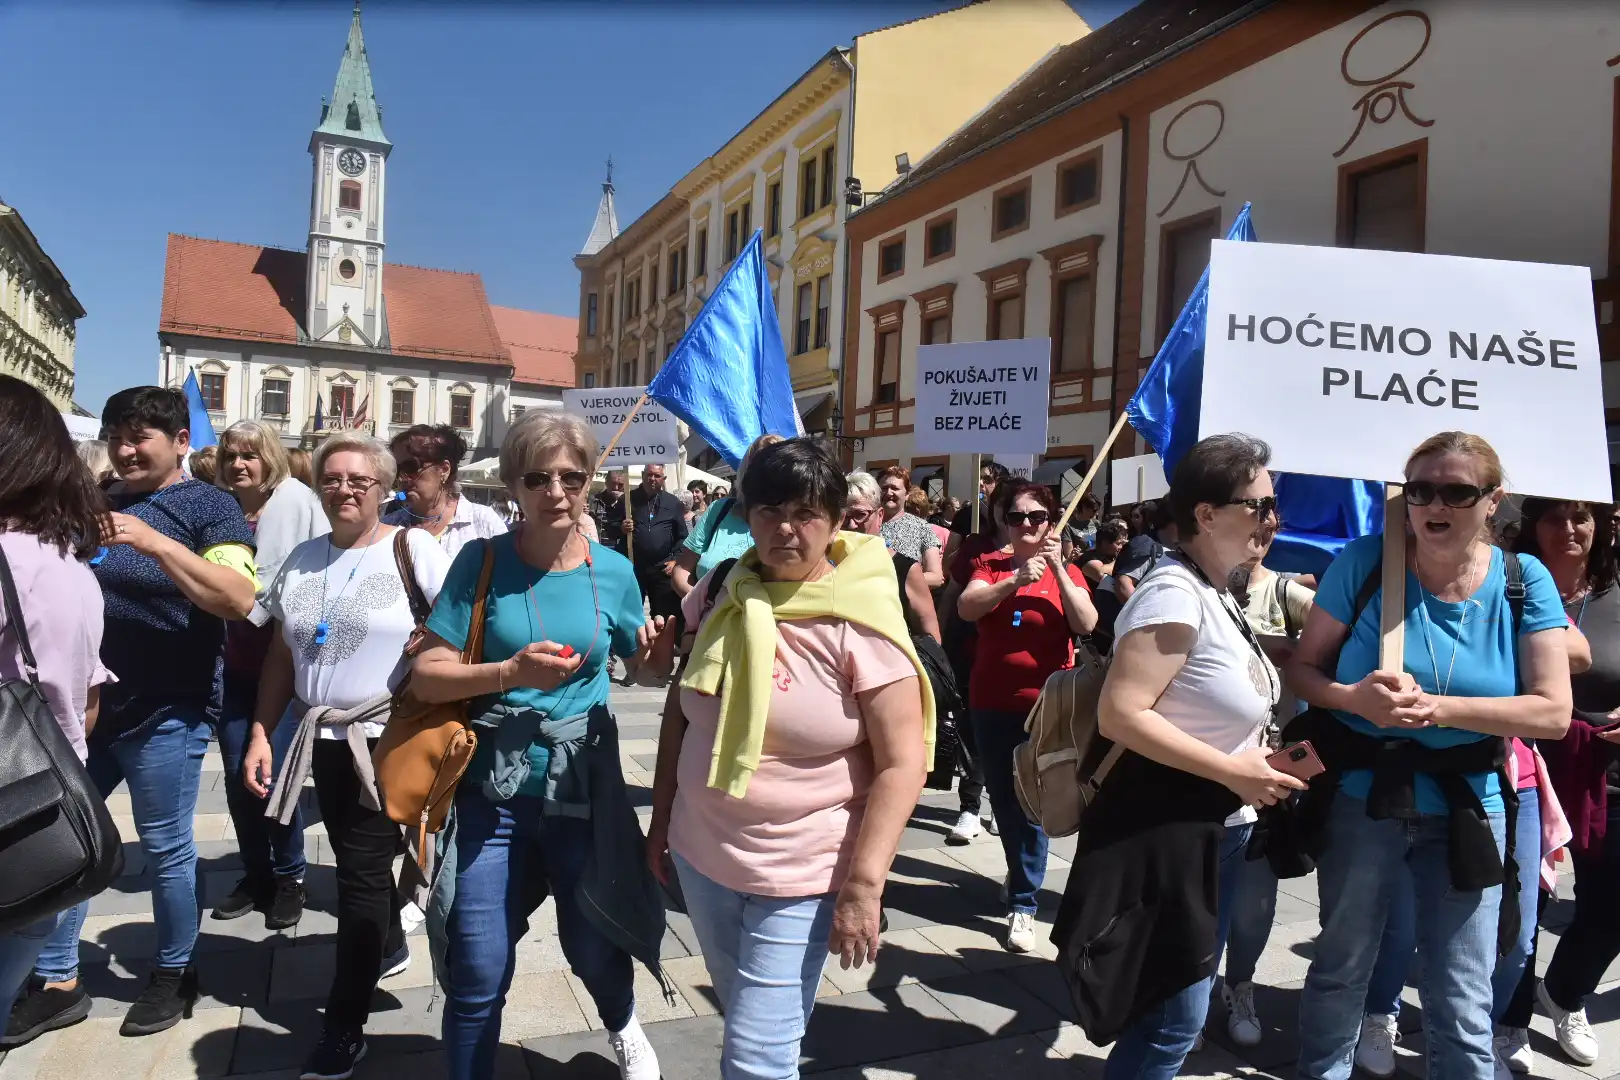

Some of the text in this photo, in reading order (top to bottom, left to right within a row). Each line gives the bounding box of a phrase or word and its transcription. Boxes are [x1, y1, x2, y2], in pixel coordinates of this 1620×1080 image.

[1227, 313, 1578, 370] HOĆEMO NAŠE
[924, 366, 1038, 385] POKUŠAJTE VI
[949, 389, 1007, 406] ŽIVJETI
[1322, 367, 1480, 411] PLAĆE
[580, 396, 658, 409] VJEROVNCI,
[585, 413, 609, 426] MO
[632, 412, 667, 423] STOL.
[934, 412, 1022, 431] BEZ PLAĆE
[598, 444, 666, 456] ŽETE VI TO
